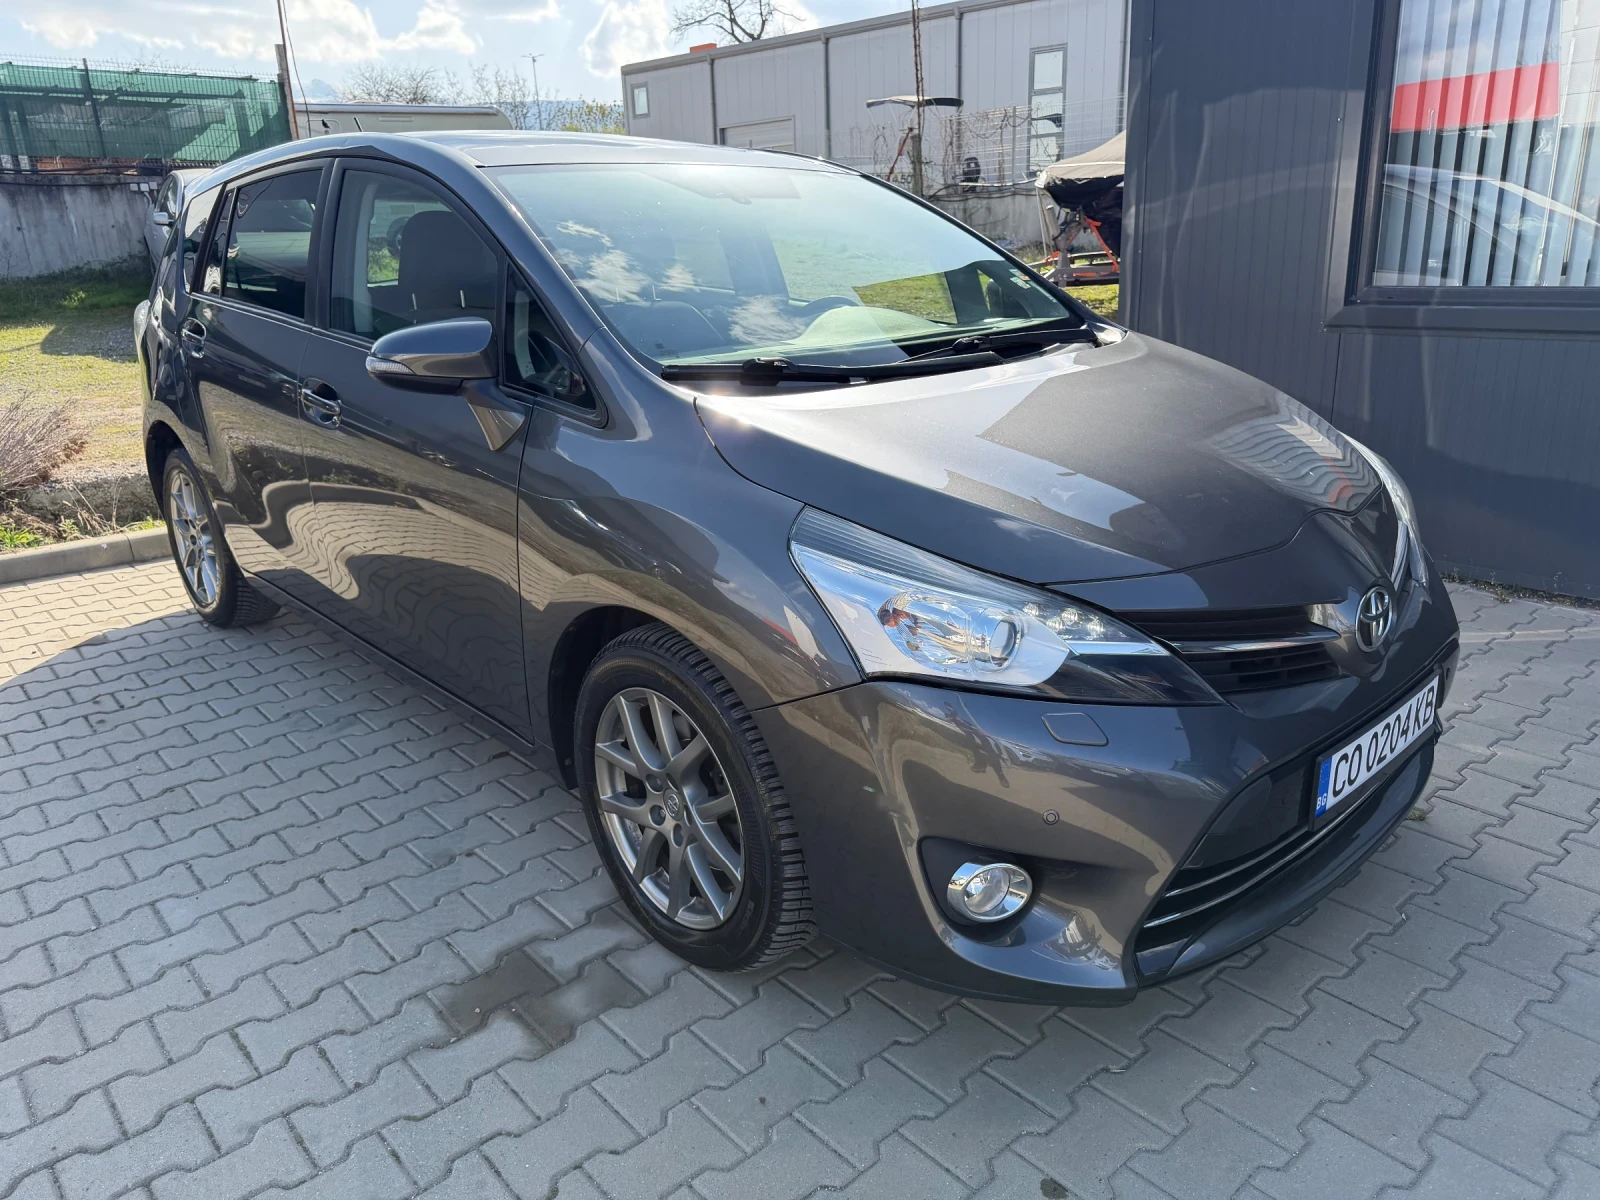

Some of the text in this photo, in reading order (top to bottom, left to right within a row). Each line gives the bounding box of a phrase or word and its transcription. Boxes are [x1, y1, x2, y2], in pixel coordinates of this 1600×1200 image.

[1332, 685, 1435, 798] CO 0204 KB
[1316, 793, 1327, 809] BG
